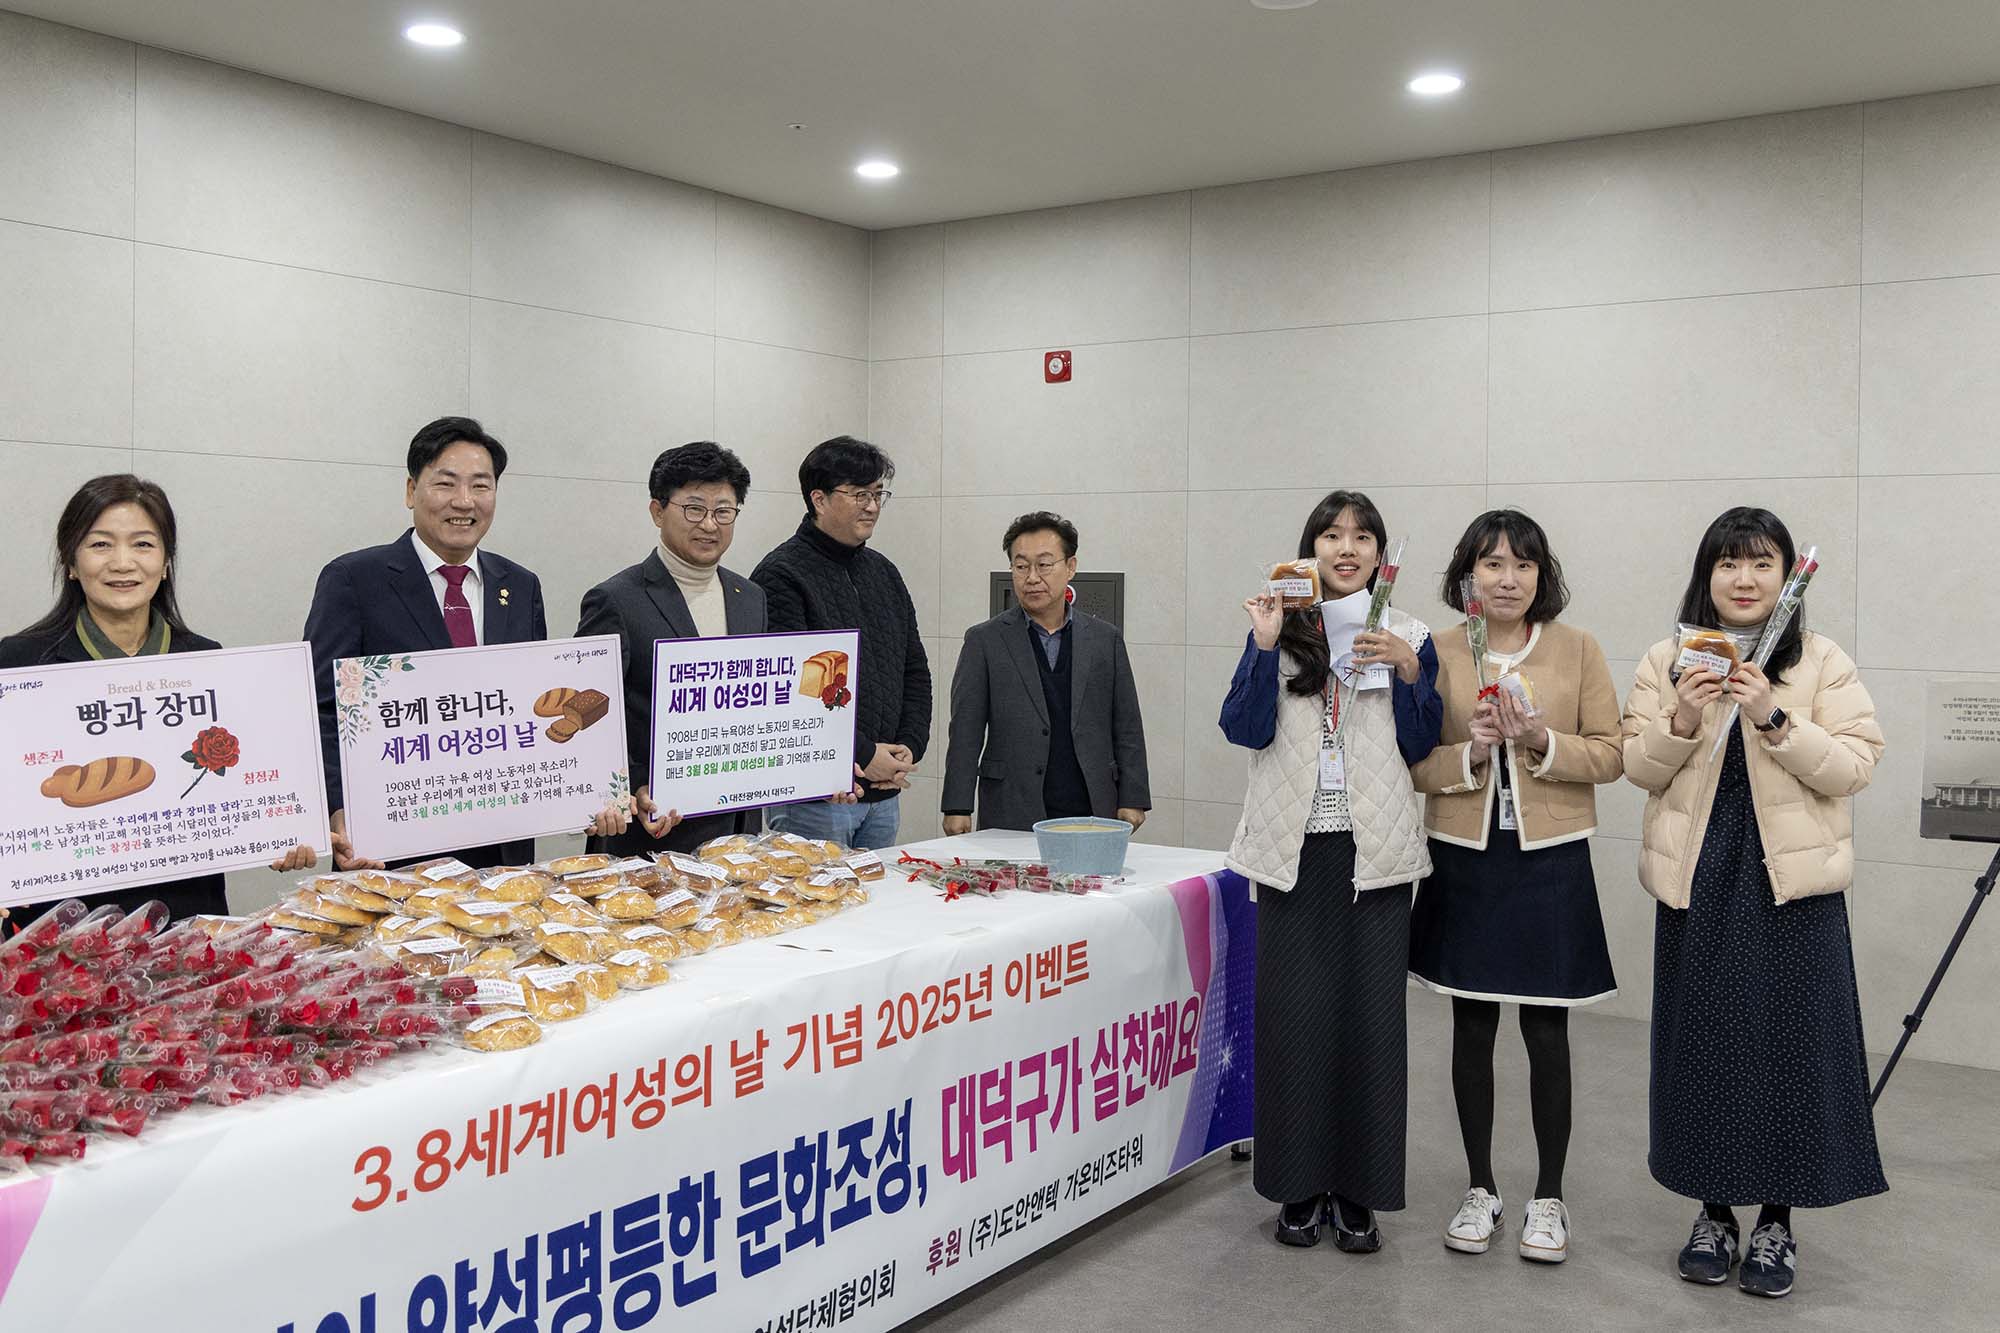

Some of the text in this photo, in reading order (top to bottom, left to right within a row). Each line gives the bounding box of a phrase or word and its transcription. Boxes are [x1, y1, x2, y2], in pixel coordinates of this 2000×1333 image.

[107, 678, 192, 694] Bread & Roses
[669, 656, 796, 683] 대덕구가 함께 합니다,
[76, 689, 217, 735] 빵과 장미
[378, 689, 513, 728] 함께 합니다,
[669, 681, 792, 713] 세계 여성의 날
[381, 722, 537, 764] 세계 여성의 날
[667, 717, 824, 743] 1908년 미국 뉴욕여성 노동자의 목소리가
[24, 749, 64, 766] 생존권
[666, 749, 835, 779] 매년 3월 8일 세계 여성의 날을 기억해 주세요
[667, 736, 813, 761] 오늘날 우리에게 여전히 닿고 있습니다.
[386, 758, 578, 793] 1908년 미국 뉴욕 여성 노동자의 목소리가
[387, 774, 565, 807] 오늘날 우리에게 여전히 닿고 있습니다.
[388, 784, 594, 822] 매년 3월 8일 세계 여성의 날을 기억해 주세요
[730, 786, 794, 802] 대전광역시 대덕구
[31, 839, 54, 852] 빵은
[58, 834, 90, 848] 남성과
[95, 828, 126, 841] 비교해
[131, 822, 172, 836] 저임금에
[177, 816, 217, 830] 시달리던
[221, 809, 260, 823] 여성들의
[265, 803, 306, 817] 생존권을,
[55, 819, 108, 835] 노동자들은
[162, 808, 183, 820] 빵과
[187, 804, 216, 816] 장미를
[258, 792, 299, 806] 외쳤는데,
[11, 837, 299, 889] 전 세계적으로 3월 8일 여성의 날이 되면 빵과 장미를 나눠주는 풍습이 있어요!
[74, 846, 105, 858] 장미는
[111, 838, 152, 853] 참정권을
[157, 834, 187, 847] 뜻하는
[731, 940, 1089, 1098] 날 기념 2025년 이벤트
[352, 1063, 713, 1212] 3.8세계여성의
[736, 1098, 927, 1278] 문화조성,
[941, 1037, 1082, 1184] 대덕구가
[1090, 996, 1200, 1122] 실천해요
[926, 1227, 961, 1275] 후원
[1064, 1130, 1144, 1200] 가온비즈타워
